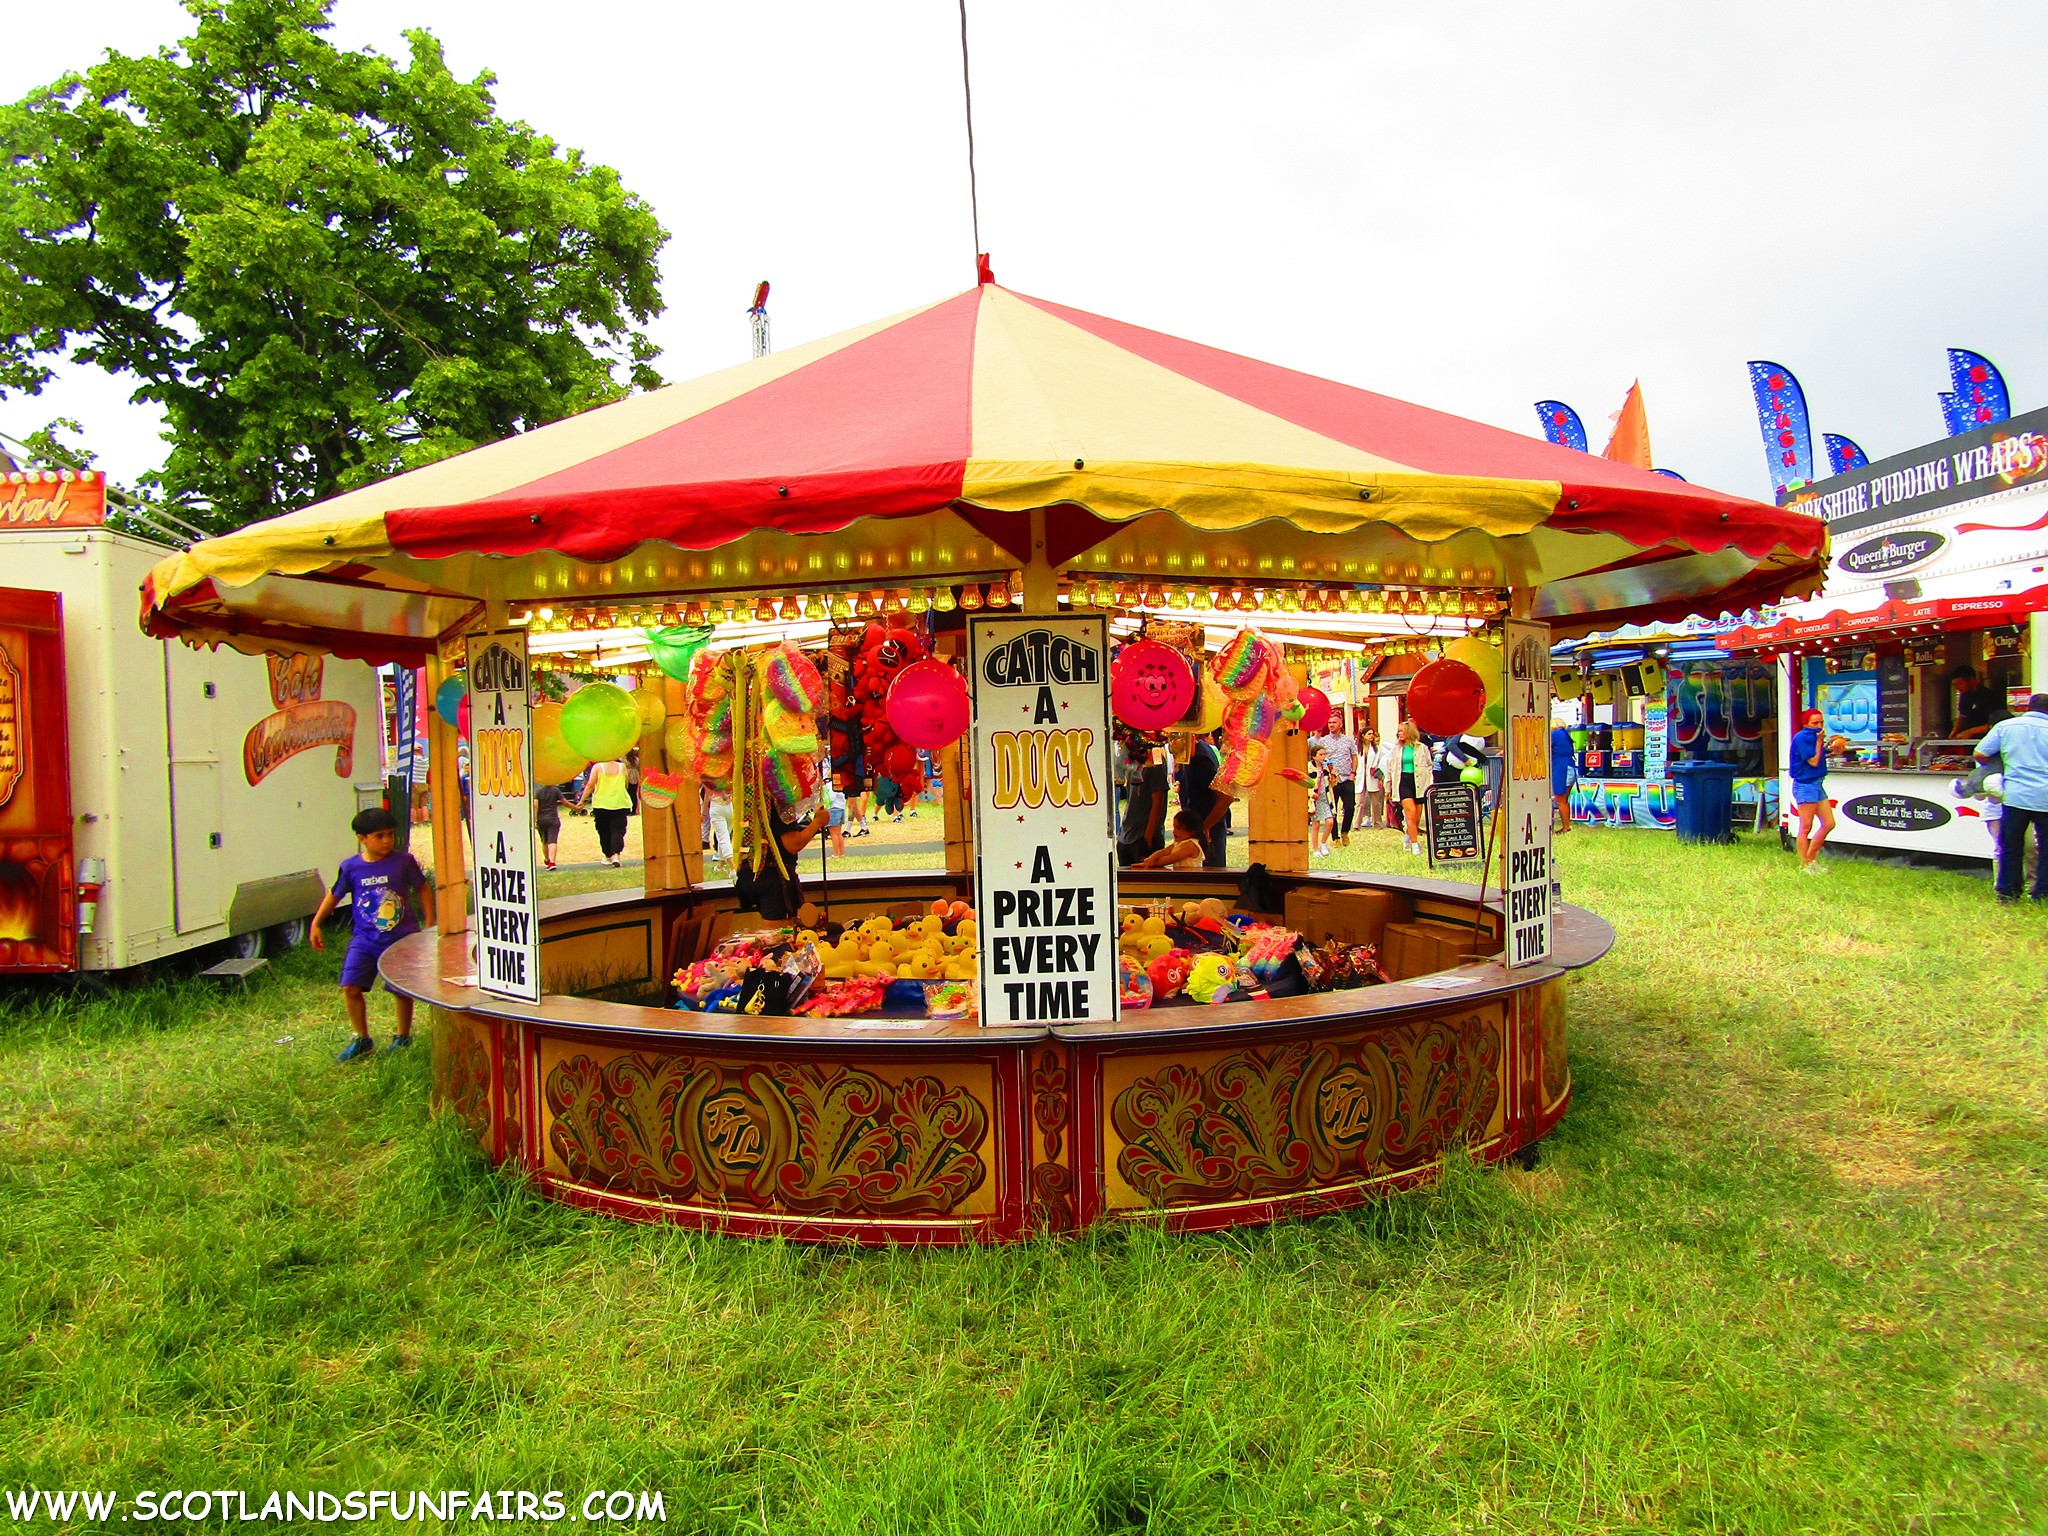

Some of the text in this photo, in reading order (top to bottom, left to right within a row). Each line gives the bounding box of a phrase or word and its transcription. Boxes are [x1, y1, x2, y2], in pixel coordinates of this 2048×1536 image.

[1767, 373, 1797, 467] SLUSH
[1870, 457, 1950, 510] PUDDING
[1952, 431, 2034, 486] WRAPS
[1849, 540, 1927, 569] Queen Burger
[1848, 616, 1879, 627] CAPPUCCINO
[1913, 608, 1931, 617] LATTE
[1951, 601, 2003, 611] ESPRESSO
[1757, 632, 1773, 640] COFFEE
[1794, 623, 1830, 635] HOT CHOCOLATE
[1994, 636, 2017, 648] Chips
[473, 642, 524, 693] CATCH
[982, 628, 1100, 687] CATCH
[1512, 634, 1548, 683] CATCH
[1915, 651, 1933, 662] Rolls
[494, 691, 506, 726] A
[1033, 686, 1058, 725] A
[1527, 682, 1536, 715] A
[478, 728, 526, 797] DUCK
[1512, 715, 1547, 781] DUCK
[991, 728, 1099, 810] DUCK
[1524, 813, 1534, 846] A
[1869, 805, 1879, 816] all
[1880, 807, 1899, 818] about
[1900, 807, 1912, 819] the
[1913, 808, 1934, 820] taste
[495, 831, 507, 864] A
[1030, 845, 1055, 884] A
[1512, 846, 1546, 884] PRIZE
[360, 875, 389, 886] POKÉMON
[480, 866, 527, 905] PRIZE
[993, 887, 1095, 929] PRIZE
[1512, 884, 1548, 924] EVERY
[482, 906, 530, 946] EVERY
[1515, 923, 1545, 963] TIME
[487, 945, 526, 986] TIME
[993, 933, 1101, 976] EVERY
[1003, 980, 1090, 1022] TIME
